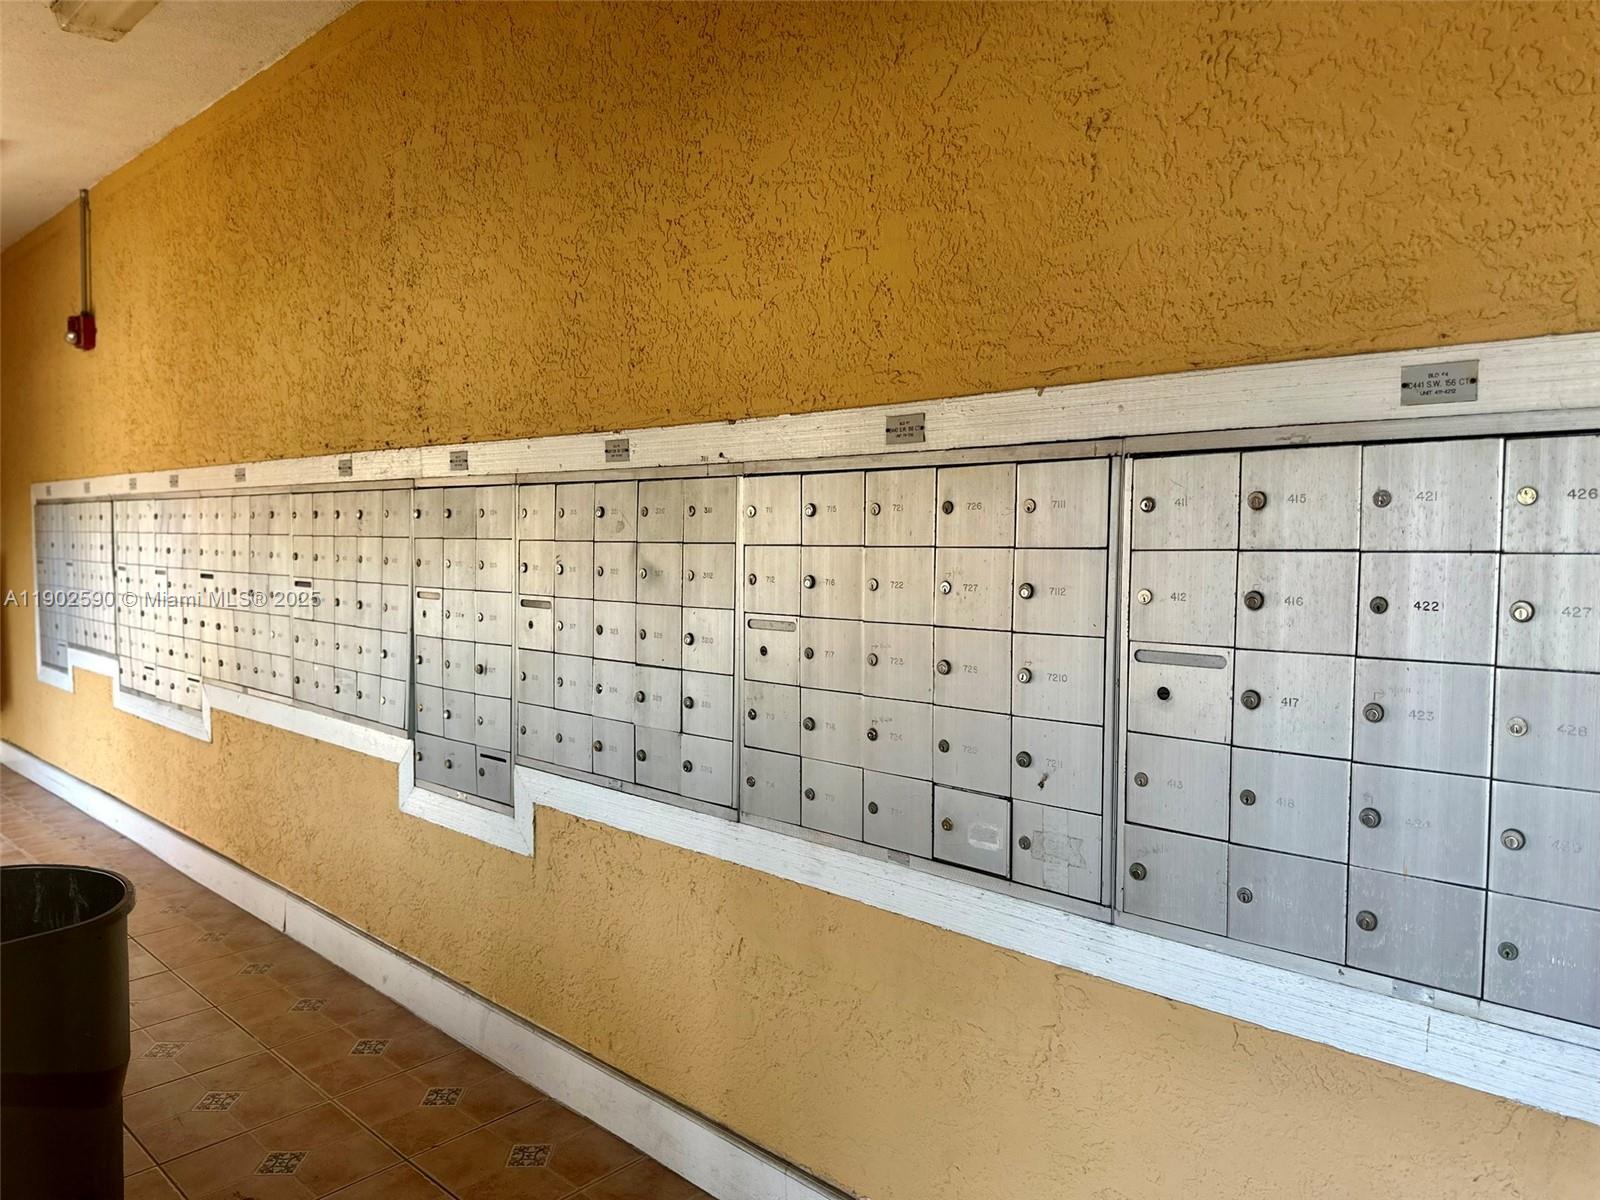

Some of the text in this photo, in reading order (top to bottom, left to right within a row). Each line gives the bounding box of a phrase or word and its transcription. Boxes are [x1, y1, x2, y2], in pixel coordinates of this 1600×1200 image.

[1287, 493, 1307, 504] 415
[1416, 490, 1438, 502] 421
[1567, 487, 1598, 500] 426
[967, 501, 982, 511] 726
[1051, 499, 1066, 509] 7111
[1174, 498, 1188, 507] 411
[890, 580, 904, 590] 722
[962, 583, 978, 593] 727
[1049, 586, 1066, 597] 7112
[1170, 592, 1187, 602] 412
[1284, 596, 1304, 607] 416
[1413, 601, 1439, 612] 422
[1561, 605, 1593, 618] 427
[1047, 672, 1068, 683] 7210
[1280, 697, 1300, 708] 417
[1408, 709, 1435, 721] 423
